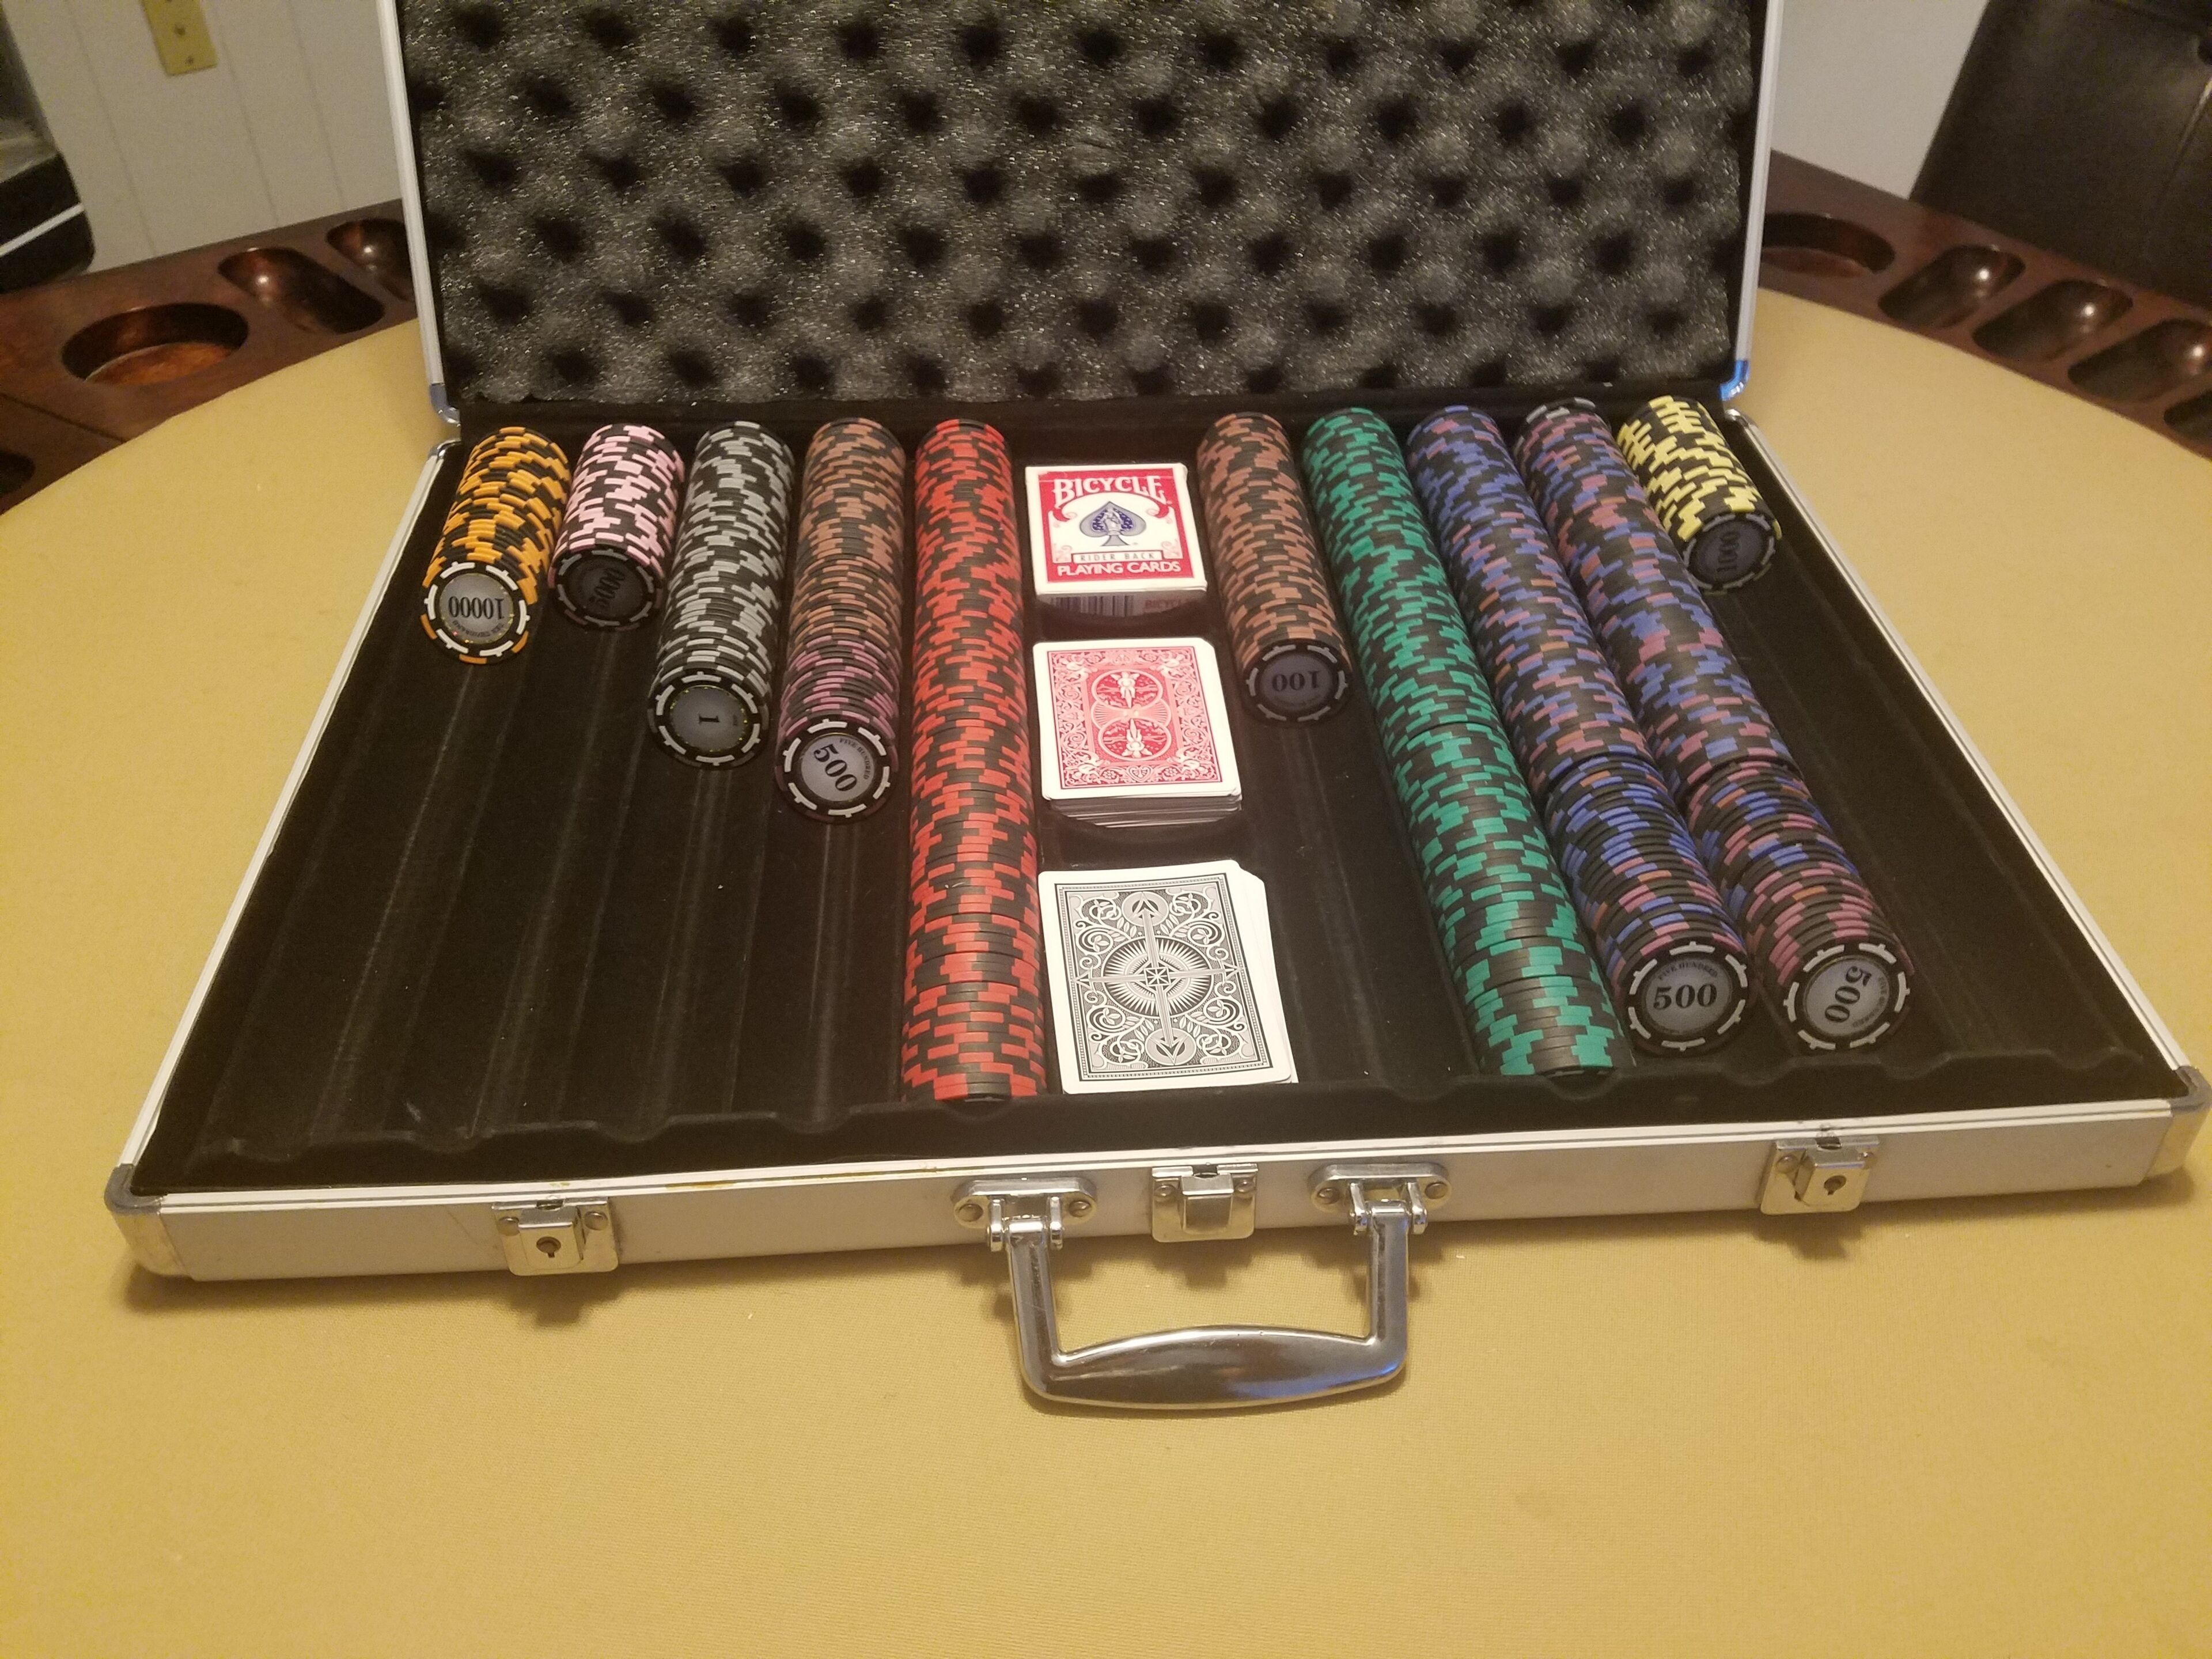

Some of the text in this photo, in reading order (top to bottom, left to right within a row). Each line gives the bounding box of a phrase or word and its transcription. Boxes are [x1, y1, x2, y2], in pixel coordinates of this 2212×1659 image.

[1052, 475, 1168, 509] BICYCLE
[1057, 561, 1181, 576] PLAYING CARDS
[1080, 552, 1155, 562] RIDER BACK
[448, 595, 505, 620] 10000
[1272, 670, 1320, 692] 100
[813, 743, 858, 793] 500
[1653, 983, 1718, 1011] 500
[1824, 965, 1872, 1023] 500
